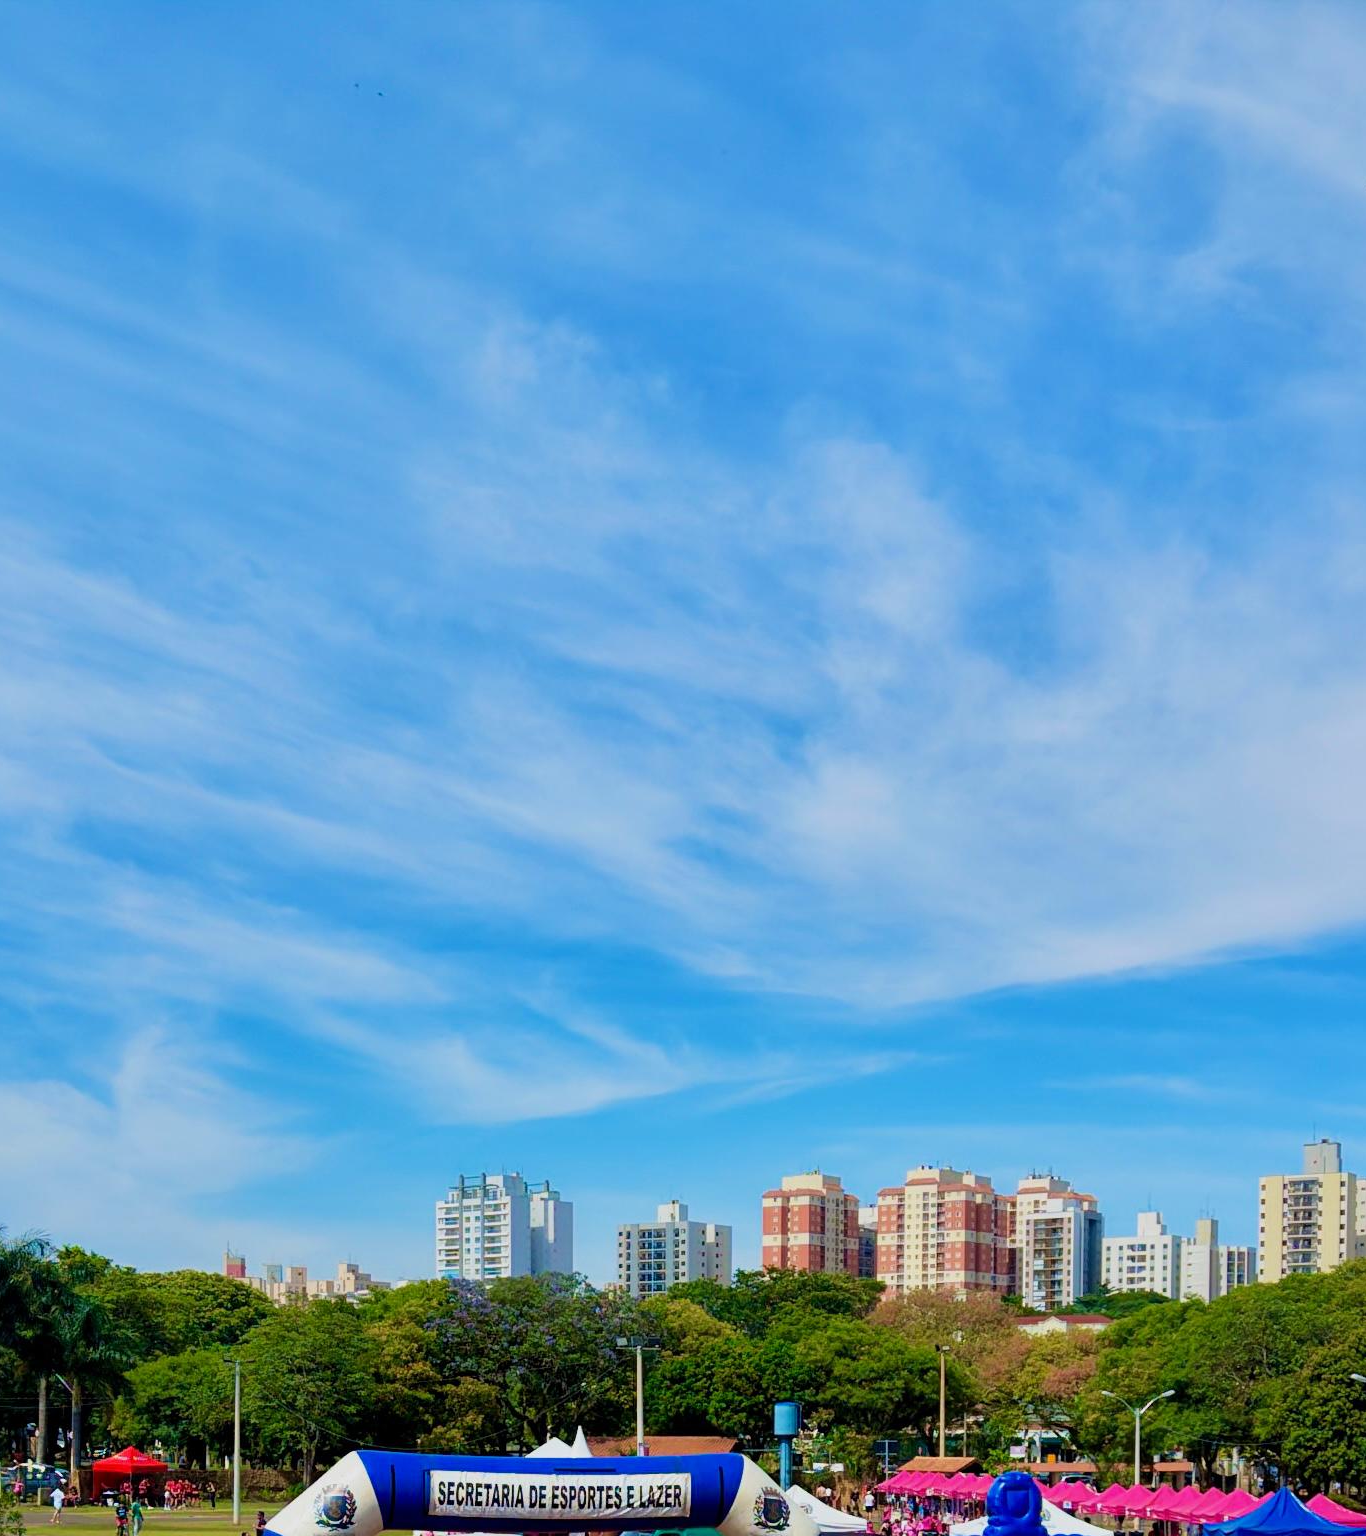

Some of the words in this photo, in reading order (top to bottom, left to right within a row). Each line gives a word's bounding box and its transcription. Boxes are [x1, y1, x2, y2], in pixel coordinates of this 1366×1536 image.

[437, 1481, 524, 1508] SECRETARIA
[529, 1485, 546, 1508] DE
[551, 1485, 621, 1510] ESPORTES
[626, 1485, 635, 1508] E
[639, 1484, 682, 1508] LAZER
